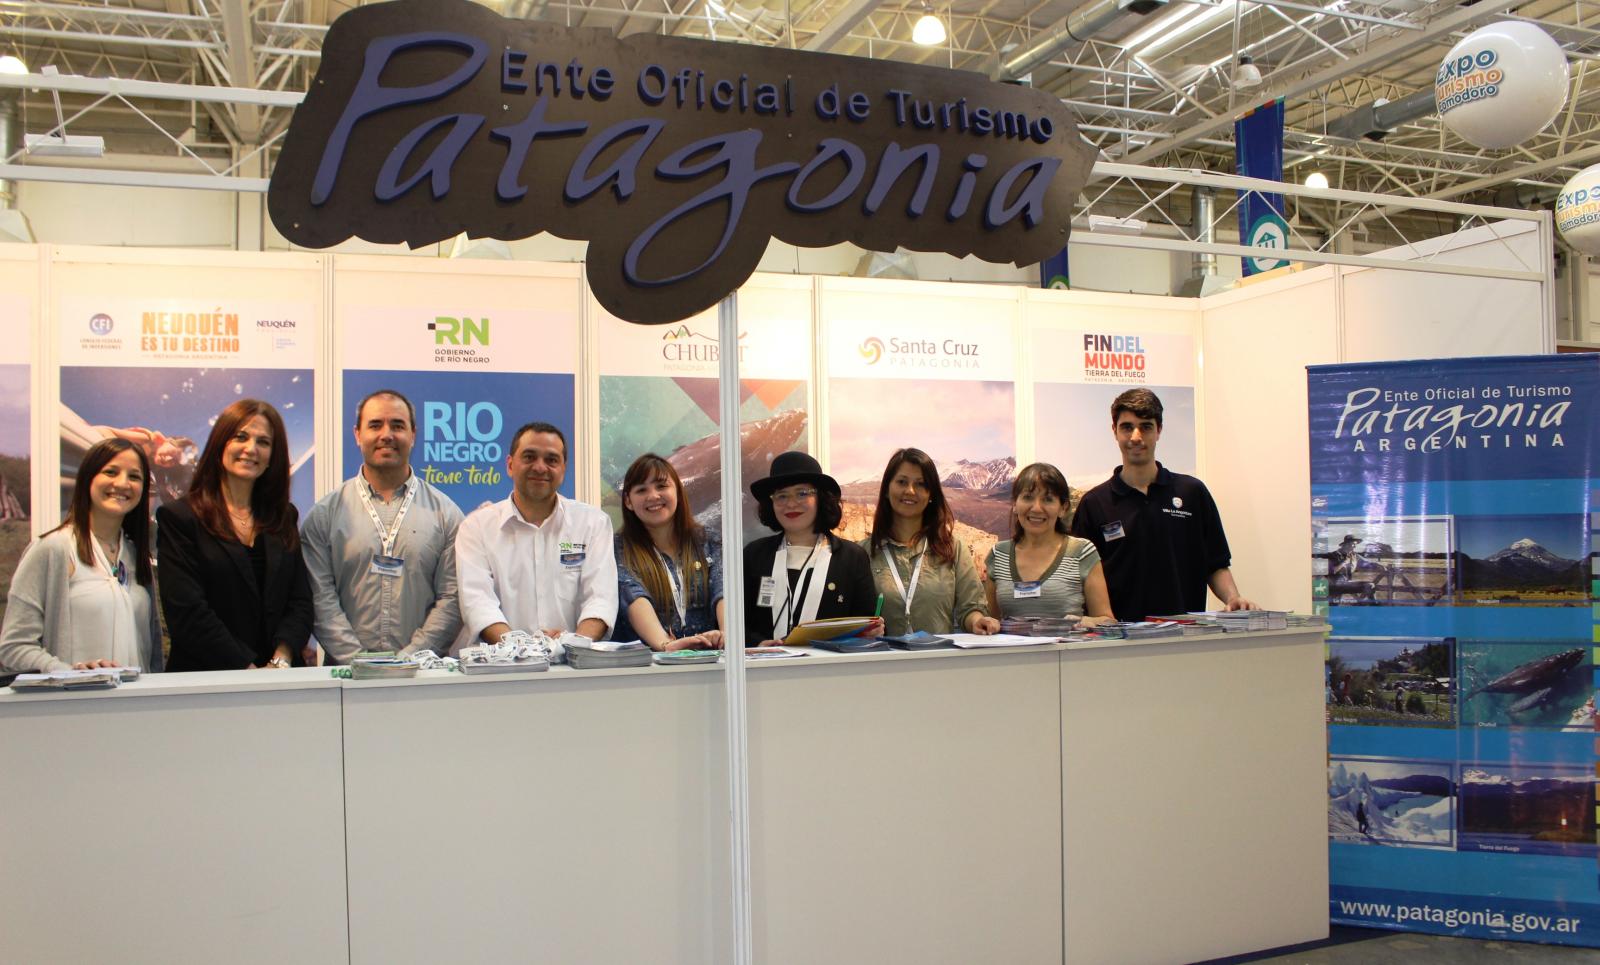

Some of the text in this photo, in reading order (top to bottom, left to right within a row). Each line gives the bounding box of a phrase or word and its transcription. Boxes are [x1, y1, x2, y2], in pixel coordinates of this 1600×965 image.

[501, 48, 1054, 143] Ente Oficial de Turismo
[309, 34, 1062, 288] Patagonia
[142, 307, 239, 336] NEUQUÉN
[435, 317, 489, 346] RN
[141, 336, 240, 353] ES TU DESTINO
[663, 343, 748, 362] CHUBT
[890, 337, 979, 356] Santa Cruz
[890, 357, 980, 369] PATAGONIA
[1085, 353, 1145, 370] MUNDO
[1384, 385, 1572, 402] Ente Oficial de Turismo
[424, 401, 503, 441] RIO
[1334, 387, 1572, 454] Patagonia
[424, 442, 502, 462] NEGRO
[1353, 433, 1565, 452] ARGENTINA
[421, 464, 501, 486] tiene todo
[1339, 900, 1581, 933] www.patagonia.gov.ar
